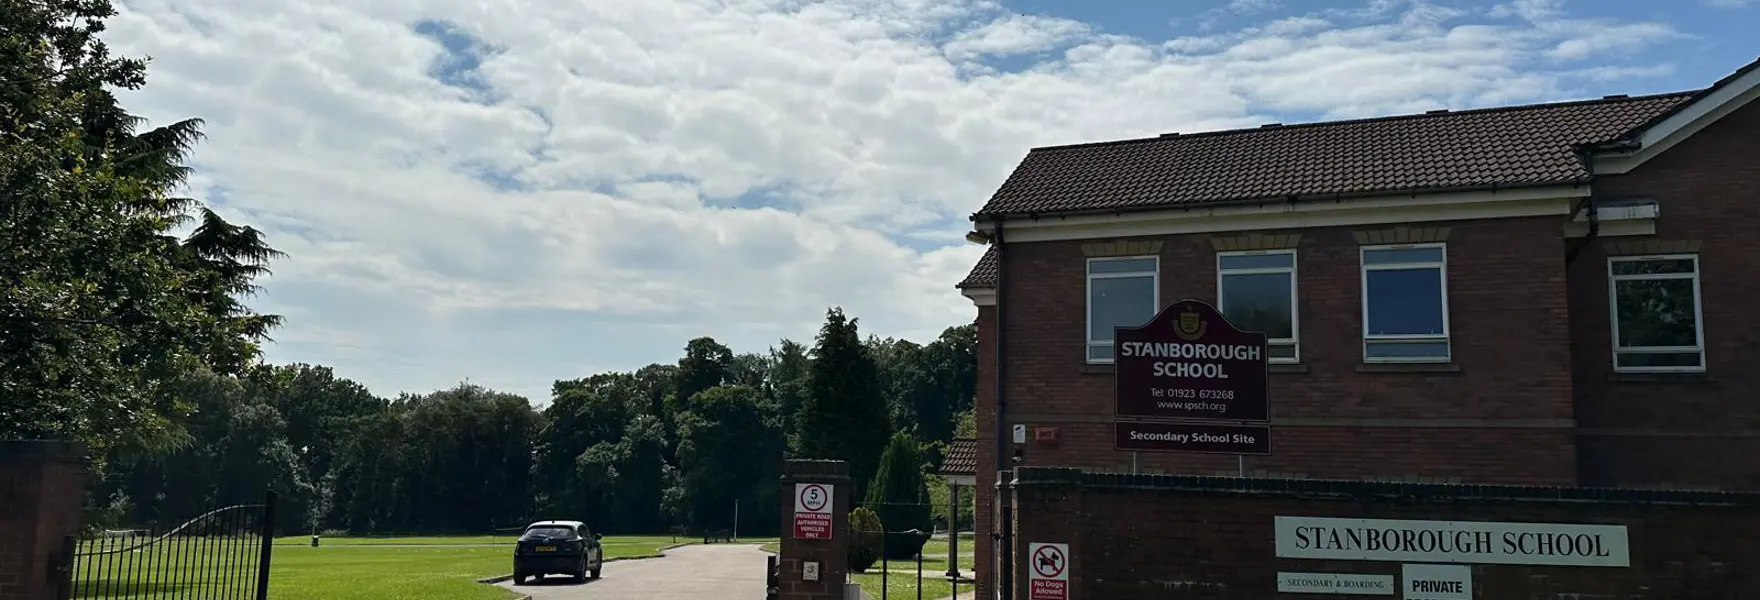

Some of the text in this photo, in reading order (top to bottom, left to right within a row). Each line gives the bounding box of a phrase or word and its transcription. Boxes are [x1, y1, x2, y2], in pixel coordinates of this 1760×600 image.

[1121, 341, 1261, 361] STANBOROUGH
[1153, 361, 1228, 379] SCHOOL
[1151, 387, 1234, 400] Tel: 01923 673268
[1156, 401, 1226, 413] www.spsch.org
[1130, 430, 1256, 444] Secondary School Site
[810, 489, 818, 500] 5
[1295, 525, 1610, 557] STANBOROUGH SCHOOL
[1045, 581, 1064, 589] Dogs
[1287, 579, 1333, 588] SECONDARY
[1344, 580, 1384, 589] BOARDING
[1412, 579, 1463, 593] PRIVATE
